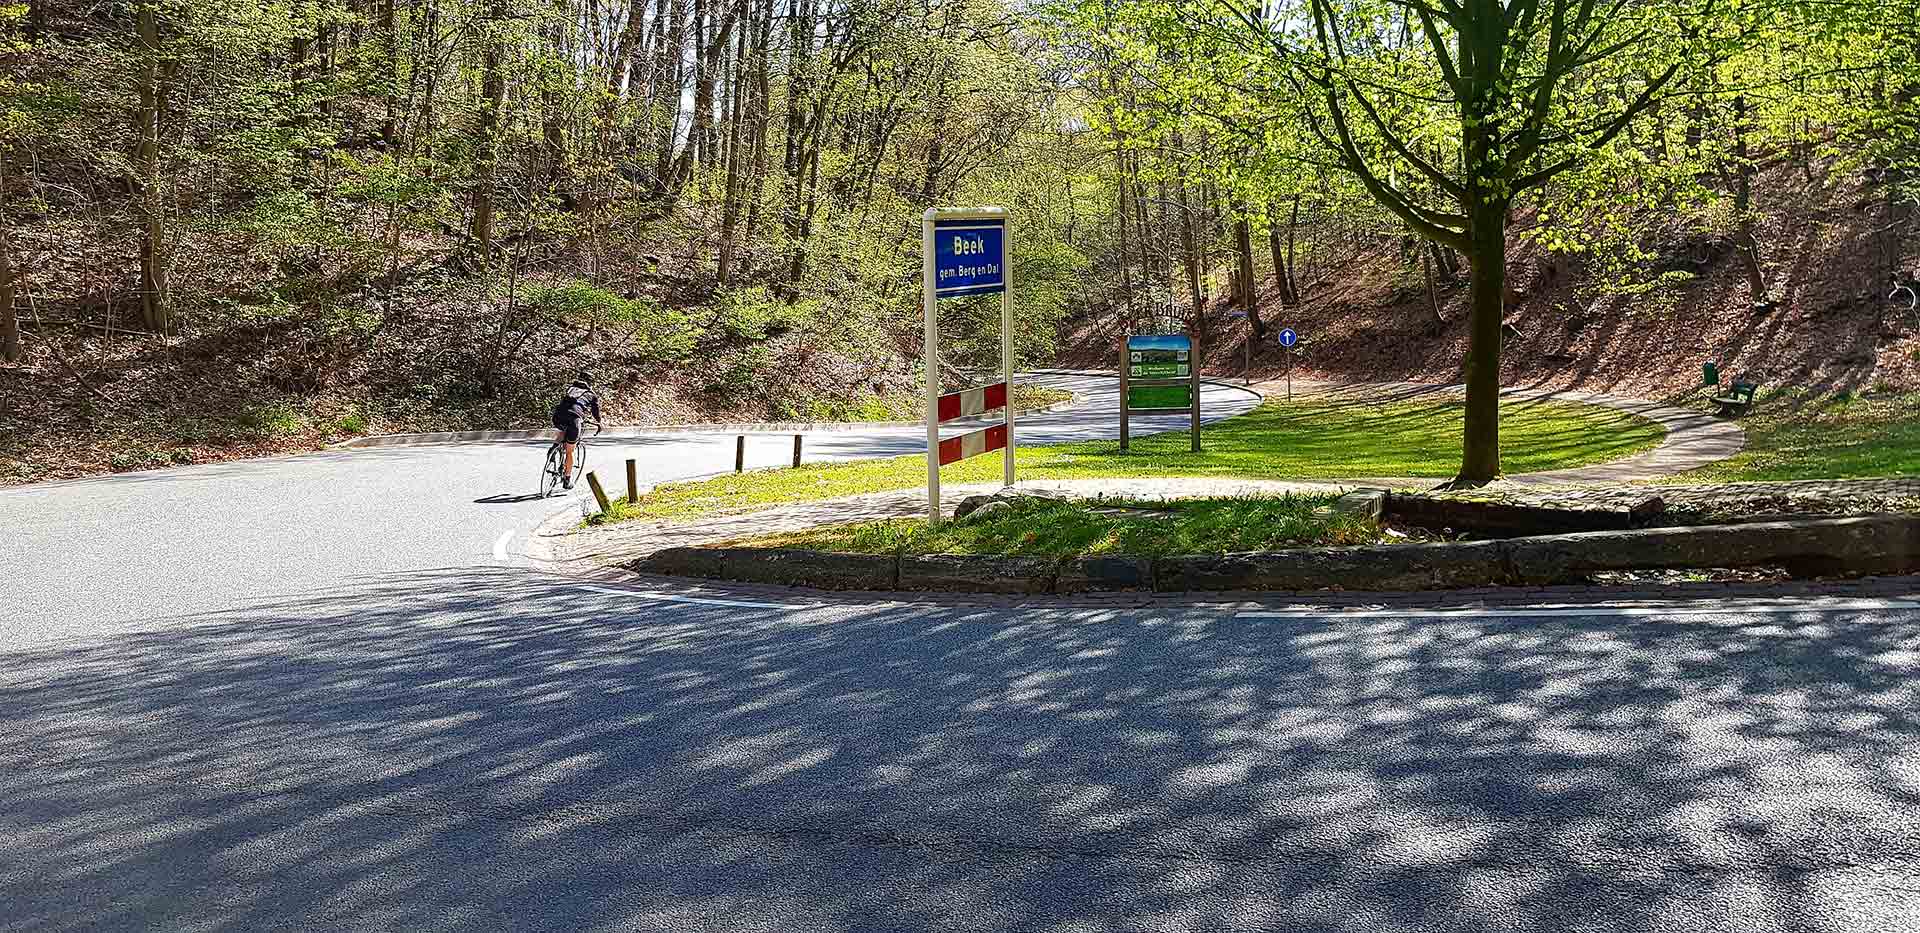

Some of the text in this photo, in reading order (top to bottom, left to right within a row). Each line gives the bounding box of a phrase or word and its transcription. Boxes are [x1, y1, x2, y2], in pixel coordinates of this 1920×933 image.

[954, 235, 984, 256] Beek
[939, 263, 999, 280] gem. Berg en Dal
